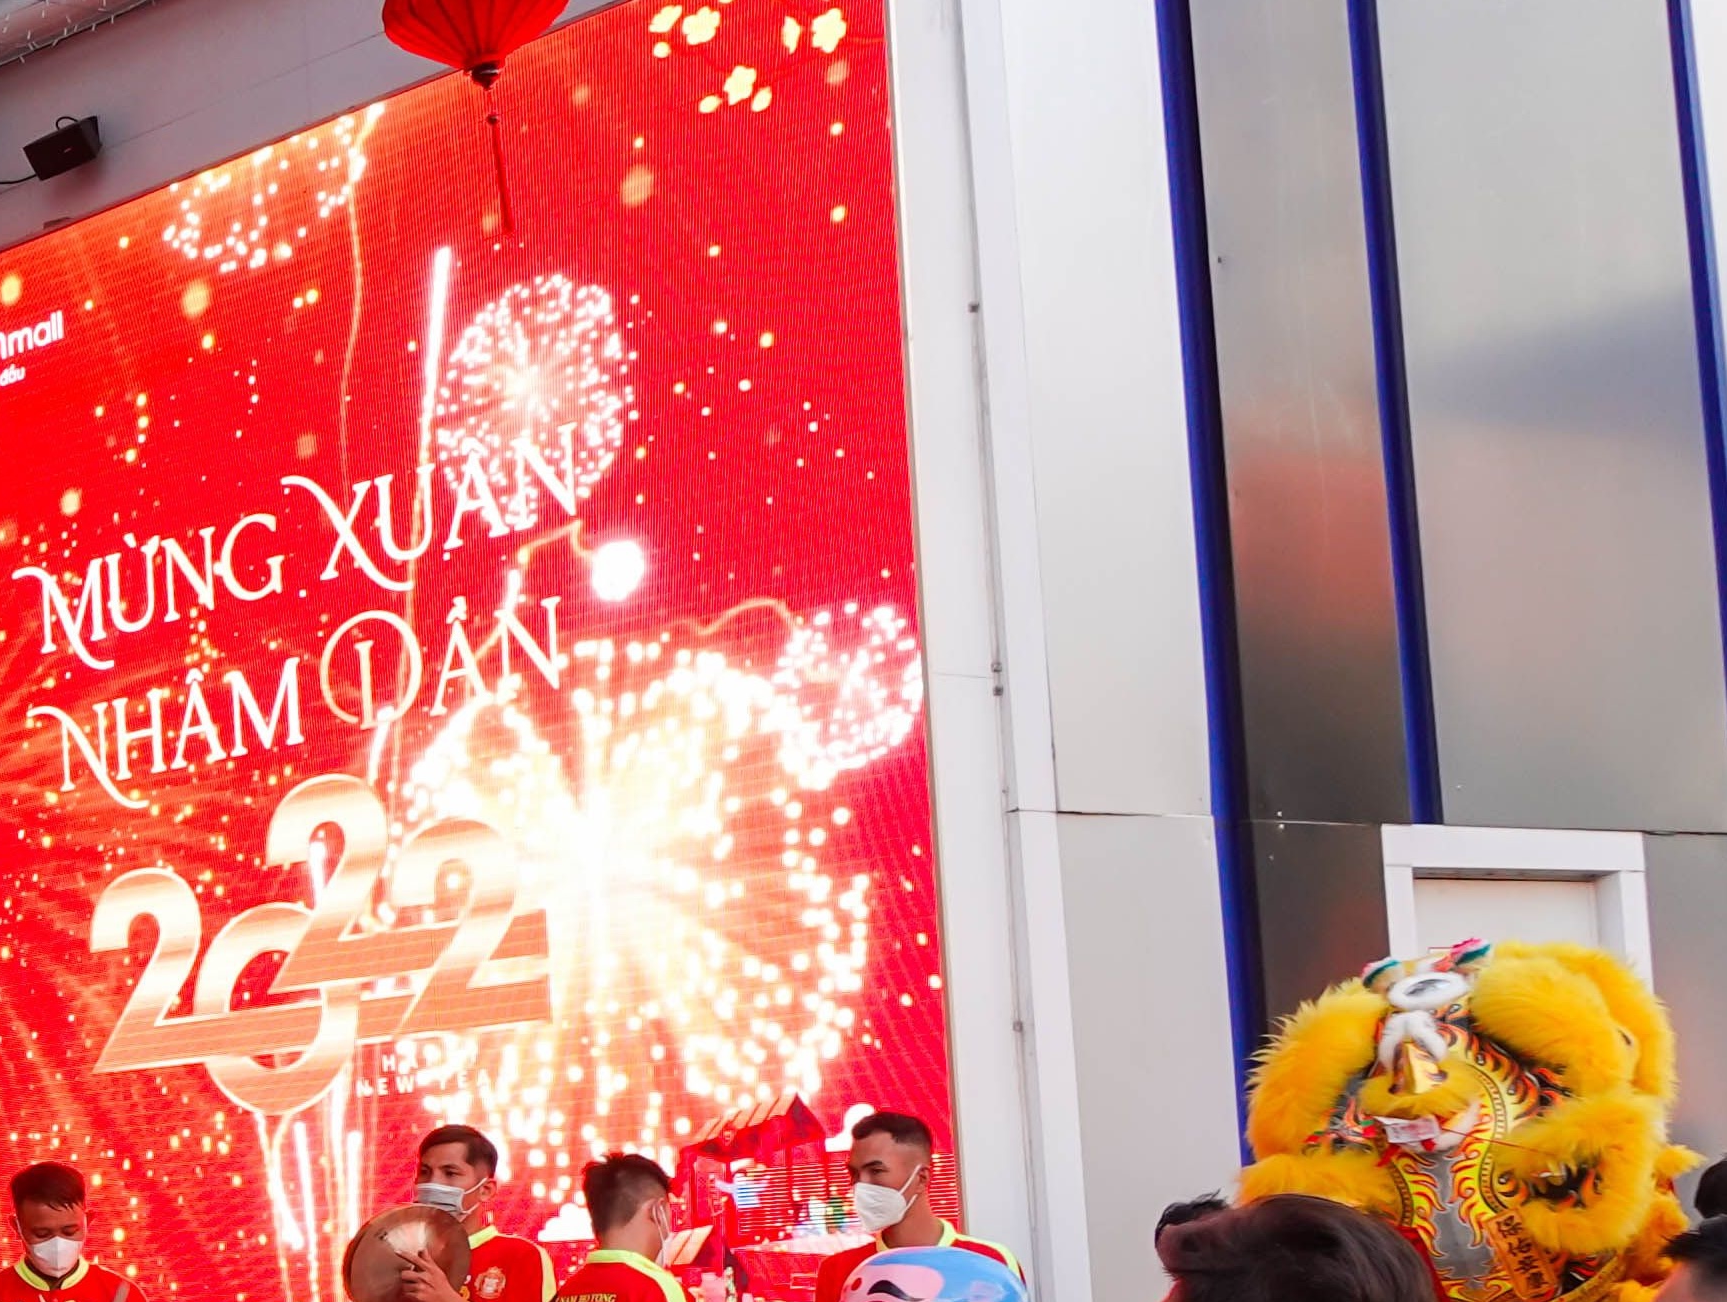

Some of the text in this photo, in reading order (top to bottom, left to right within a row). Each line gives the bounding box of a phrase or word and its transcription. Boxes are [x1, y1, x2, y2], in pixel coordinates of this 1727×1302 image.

[12, 422, 578, 671] MỪNG XUÂN
[90, 774, 552, 1115] 2022
